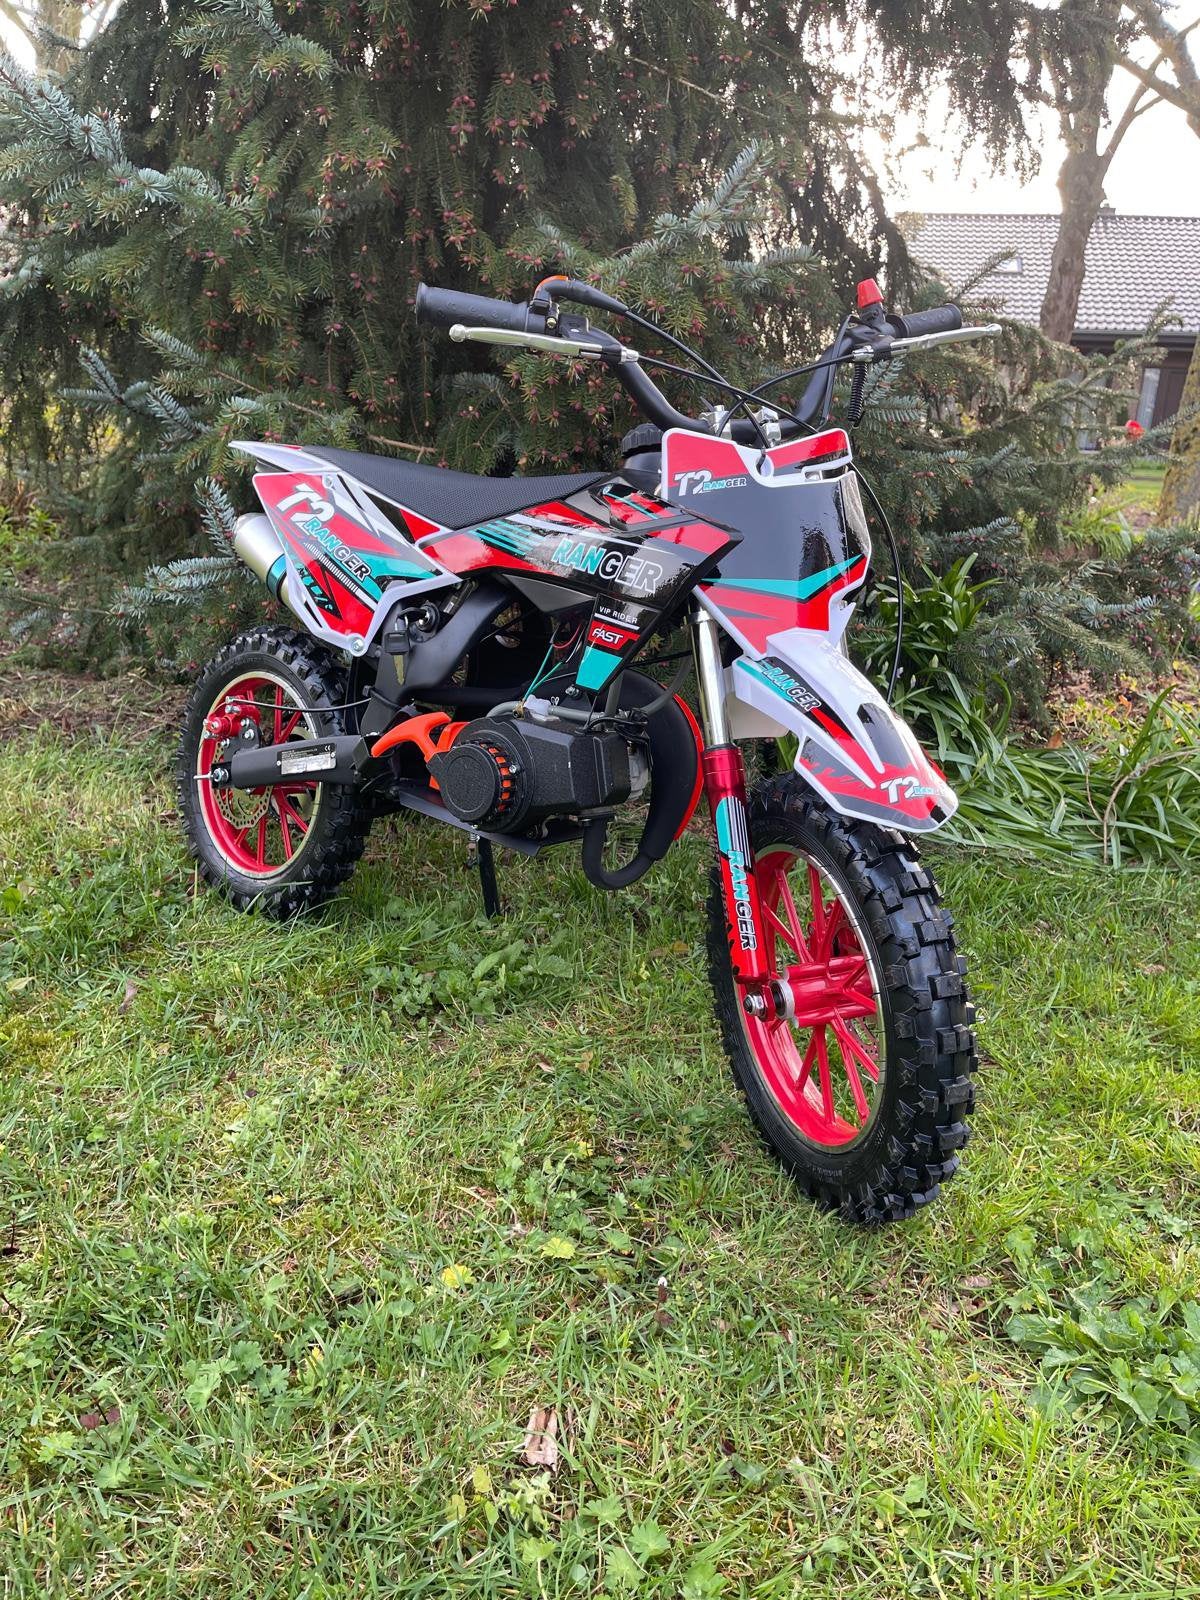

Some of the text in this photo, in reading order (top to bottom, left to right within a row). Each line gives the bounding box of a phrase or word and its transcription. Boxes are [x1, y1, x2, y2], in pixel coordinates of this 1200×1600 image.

[674, 469, 747, 497] T2 RANGER
[276, 483, 371, 581] T2 RANGER
[550, 538, 663, 593] RANGER
[599, 605, 638, 624] VIP RIDER
[591, 628, 624, 645] FAST
[763, 666, 822, 711] RANGER
[880, 776, 919, 804] T2
[727, 850, 757, 951] RANGER
